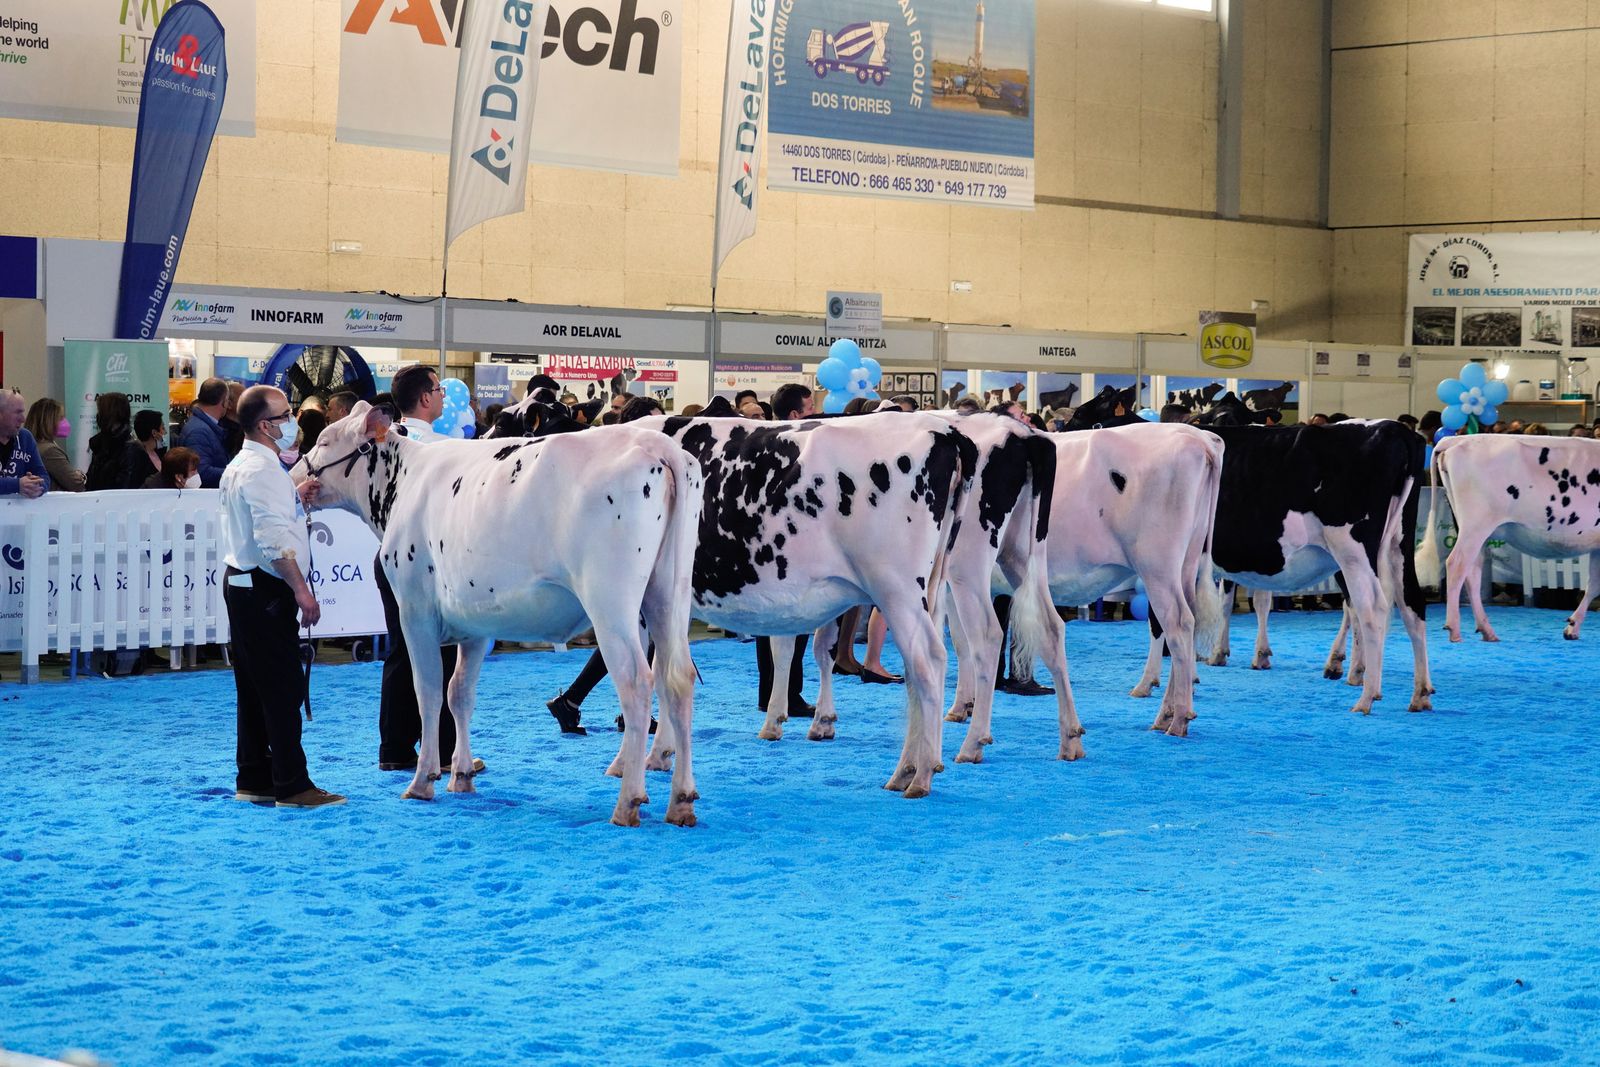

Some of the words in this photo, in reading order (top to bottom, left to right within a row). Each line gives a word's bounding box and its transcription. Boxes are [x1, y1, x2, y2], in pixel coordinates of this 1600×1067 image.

[15, 37, 49, 50] world
[909, 30, 926, 109] ROQUE
[152, 78, 180, 91] passion
[181, 82, 191, 94] for
[192, 87, 216, 101] calves
[812, 91, 838, 109] DOS
[842, 95, 891, 115] TORRES
[782, 144, 803, 157] 14460
[804, 145, 820, 158] DOS
[822, 147, 851, 161] TORRES
[857, 151, 887, 165] Córdoba
[896, 153, 968, 172] PEÑARROYA-PUEBLO
[970, 162, 992, 174] NUEVO
[998, 163, 1025, 177] Córdoba
[792, 167, 860, 187] TELEFONO
[869, 174, 889, 189] 666
[892, 176, 912, 191] 465
[914, 178, 934, 193] 330
[944, 180, 964, 195] 649
[967, 182, 985, 197] 177
[988, 184, 1007, 199] 739
[139, 235, 178, 340] olm-laue.com
[1432, 288, 1443, 296] EL
[1447, 288, 1480, 296] MEJOR
[1483, 287, 1572, 296] ASESORAMIENTO
[195, 302, 235, 314] innofarm
[251, 309, 324, 324] INNOFARM
[366, 310, 403, 322] innofarm
[543, 324, 567, 337] AOR
[571, 326, 621, 338] DELAVAL
[775, 335, 815, 346] COVIAL/
[1039, 346, 1076, 357] INATEGA
[1204, 335, 1251, 351] ASCOL
[331, 564, 363, 582] SCA
